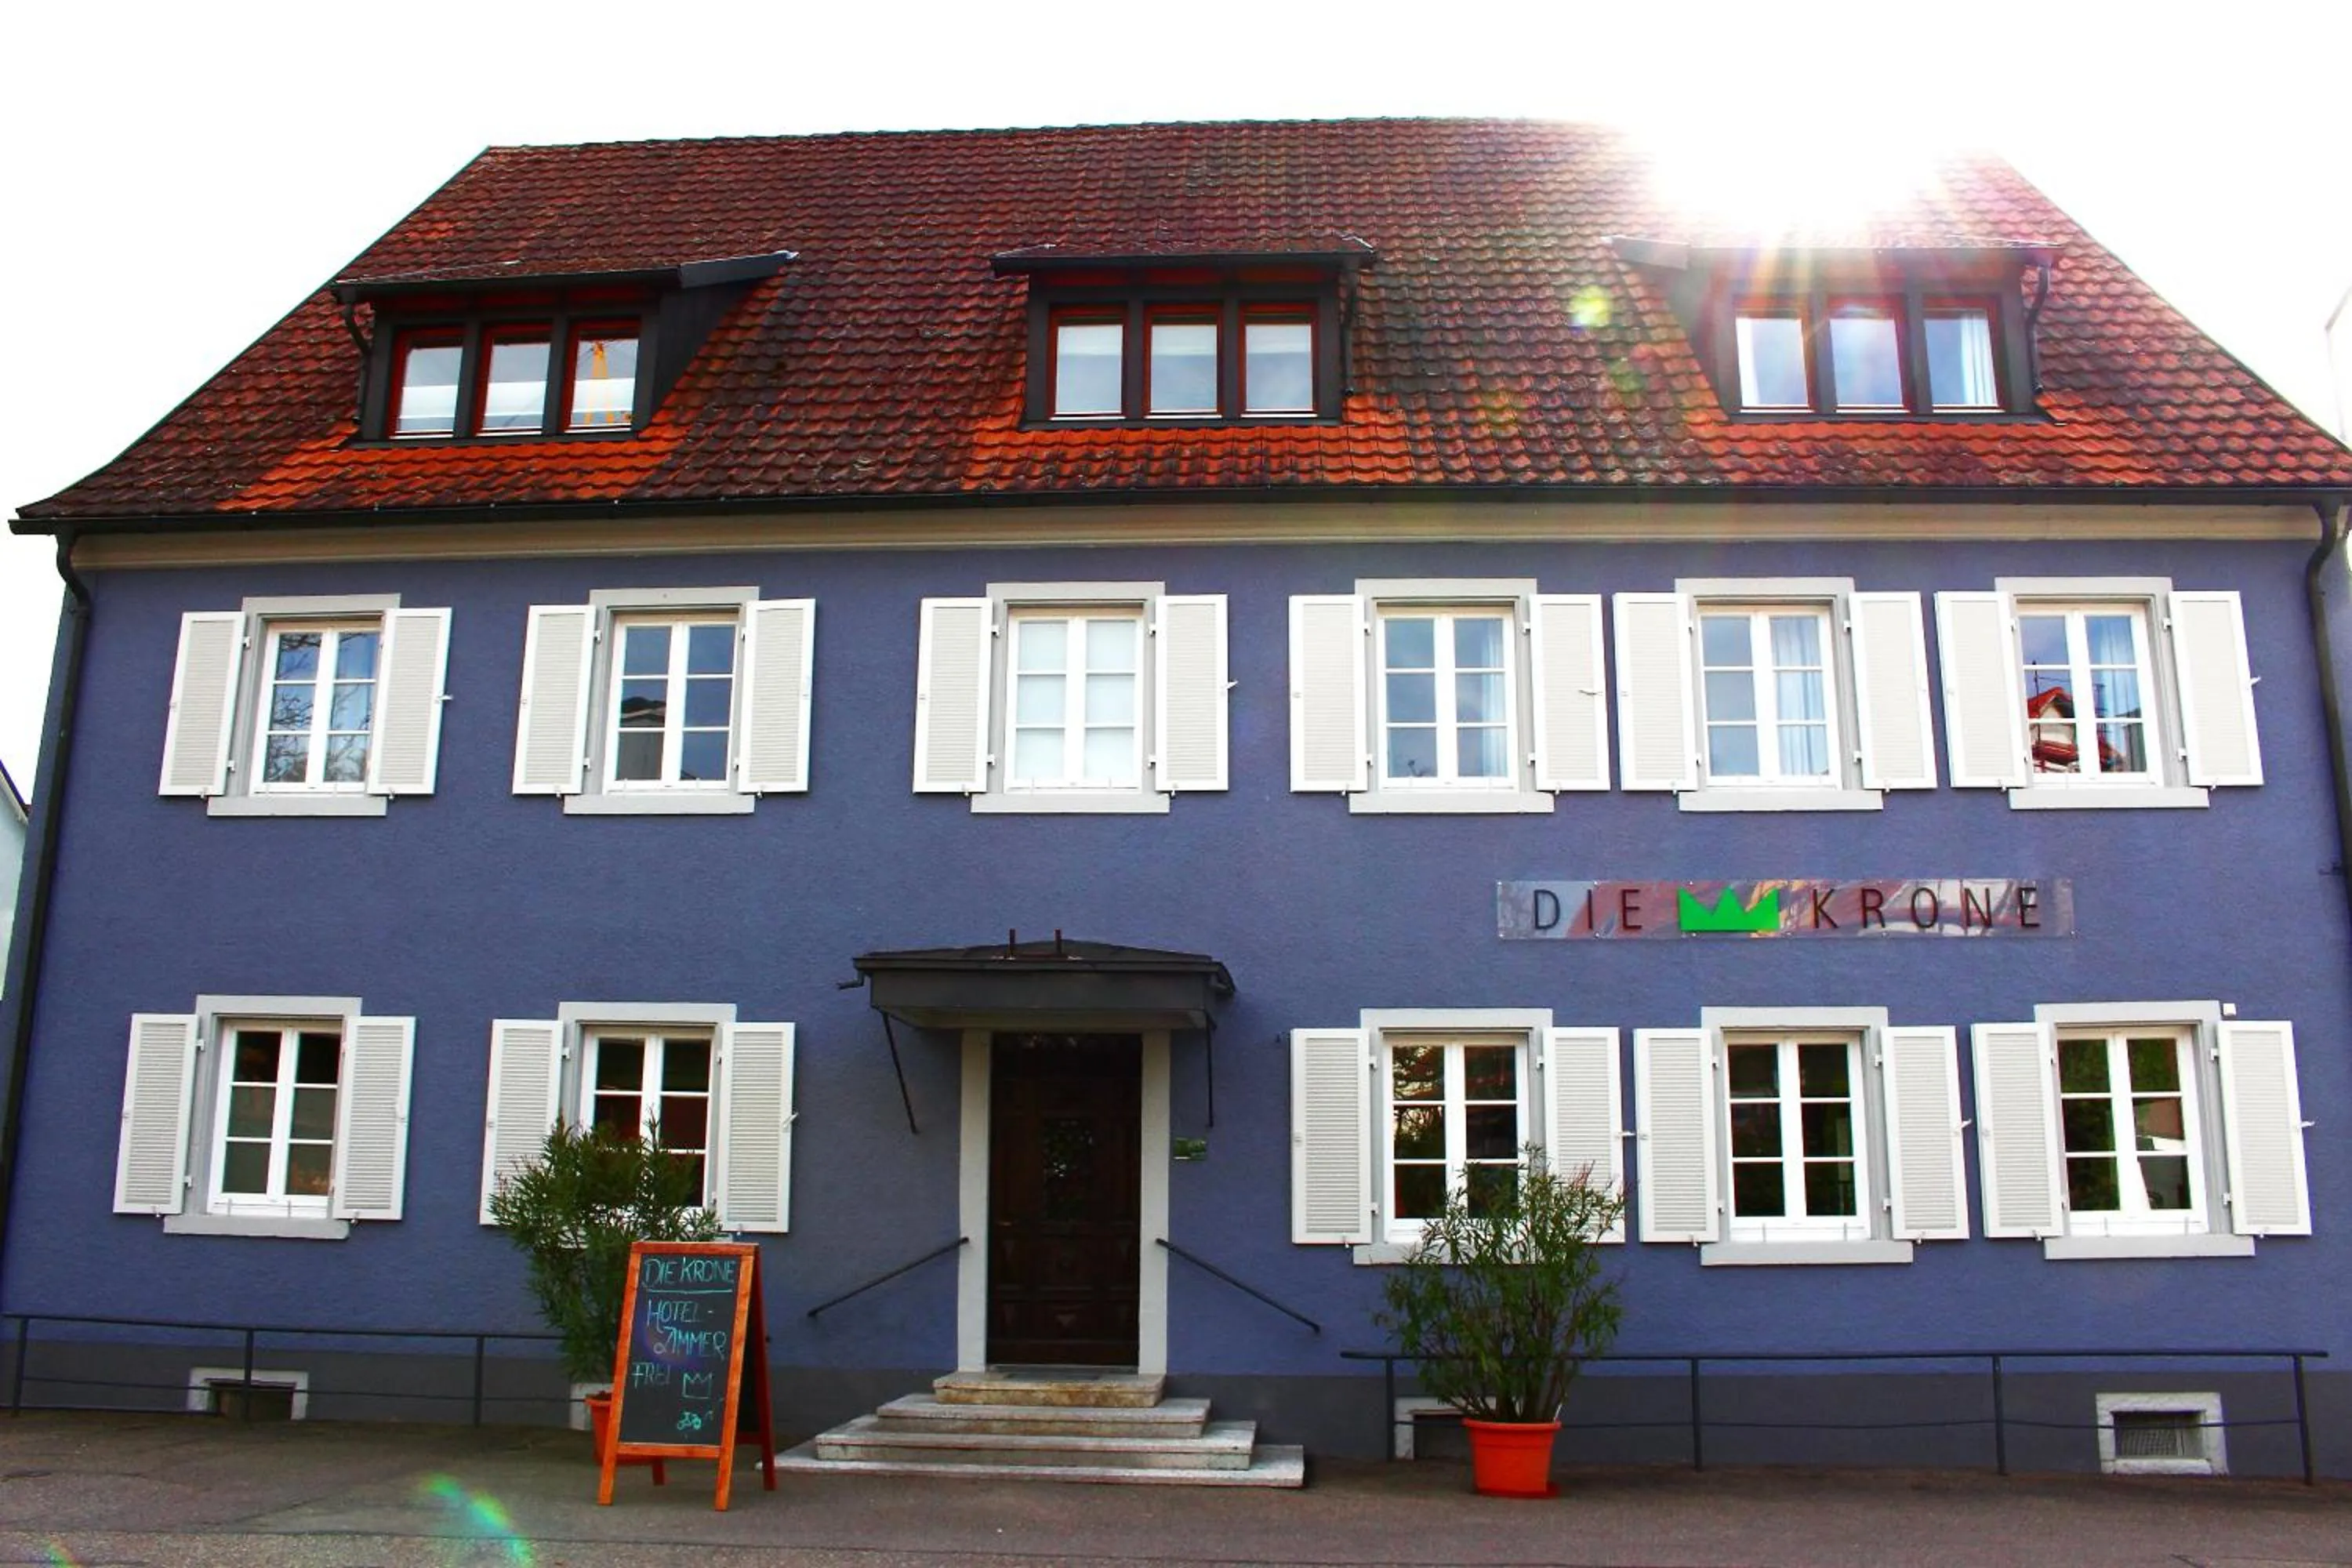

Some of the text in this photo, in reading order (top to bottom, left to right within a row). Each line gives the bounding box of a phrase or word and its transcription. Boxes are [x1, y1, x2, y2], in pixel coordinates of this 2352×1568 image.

[1533, 887, 2040, 931] DIE KRONE
[643, 1256, 735, 1287] DIE KRONE
[653, 1326, 727, 1361] ZIMMER
